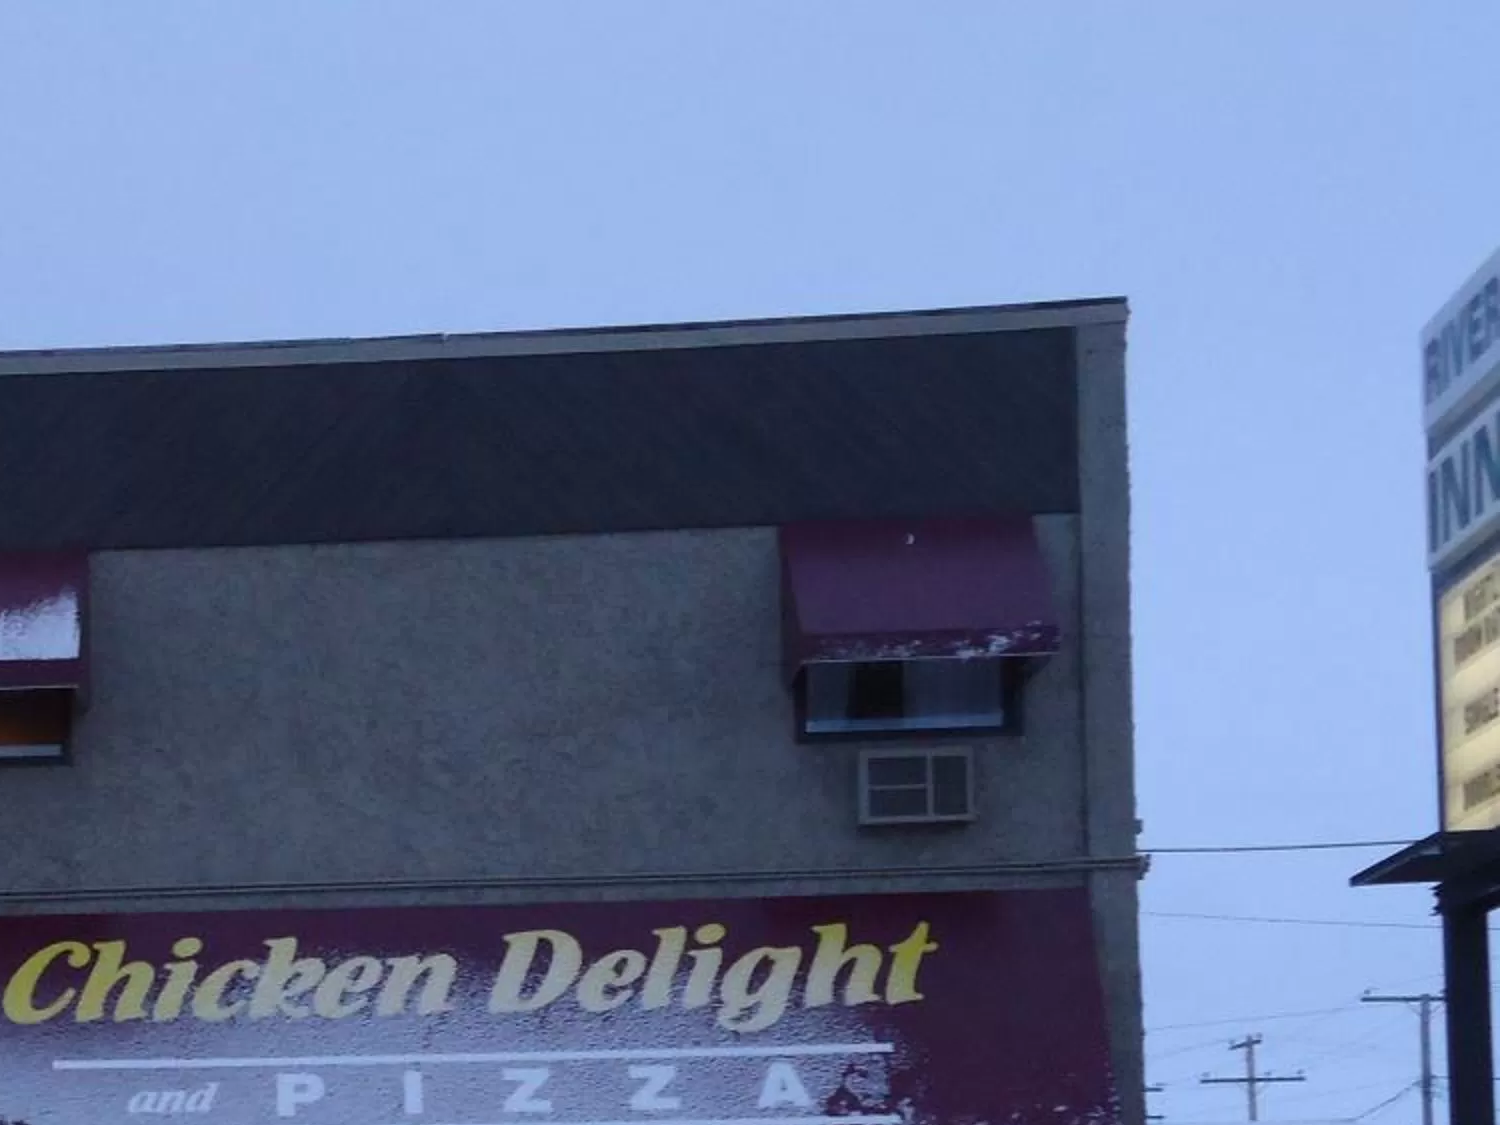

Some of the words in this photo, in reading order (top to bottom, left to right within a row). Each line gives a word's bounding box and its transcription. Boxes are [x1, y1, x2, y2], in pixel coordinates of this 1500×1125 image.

[1429, 408, 1500, 553] INN
[3, 936, 457, 1025] Chicken
[488, 921, 940, 1034] Delight
[127, 1082, 221, 1115] and
[275, 1061, 813, 1117] PIZZA
